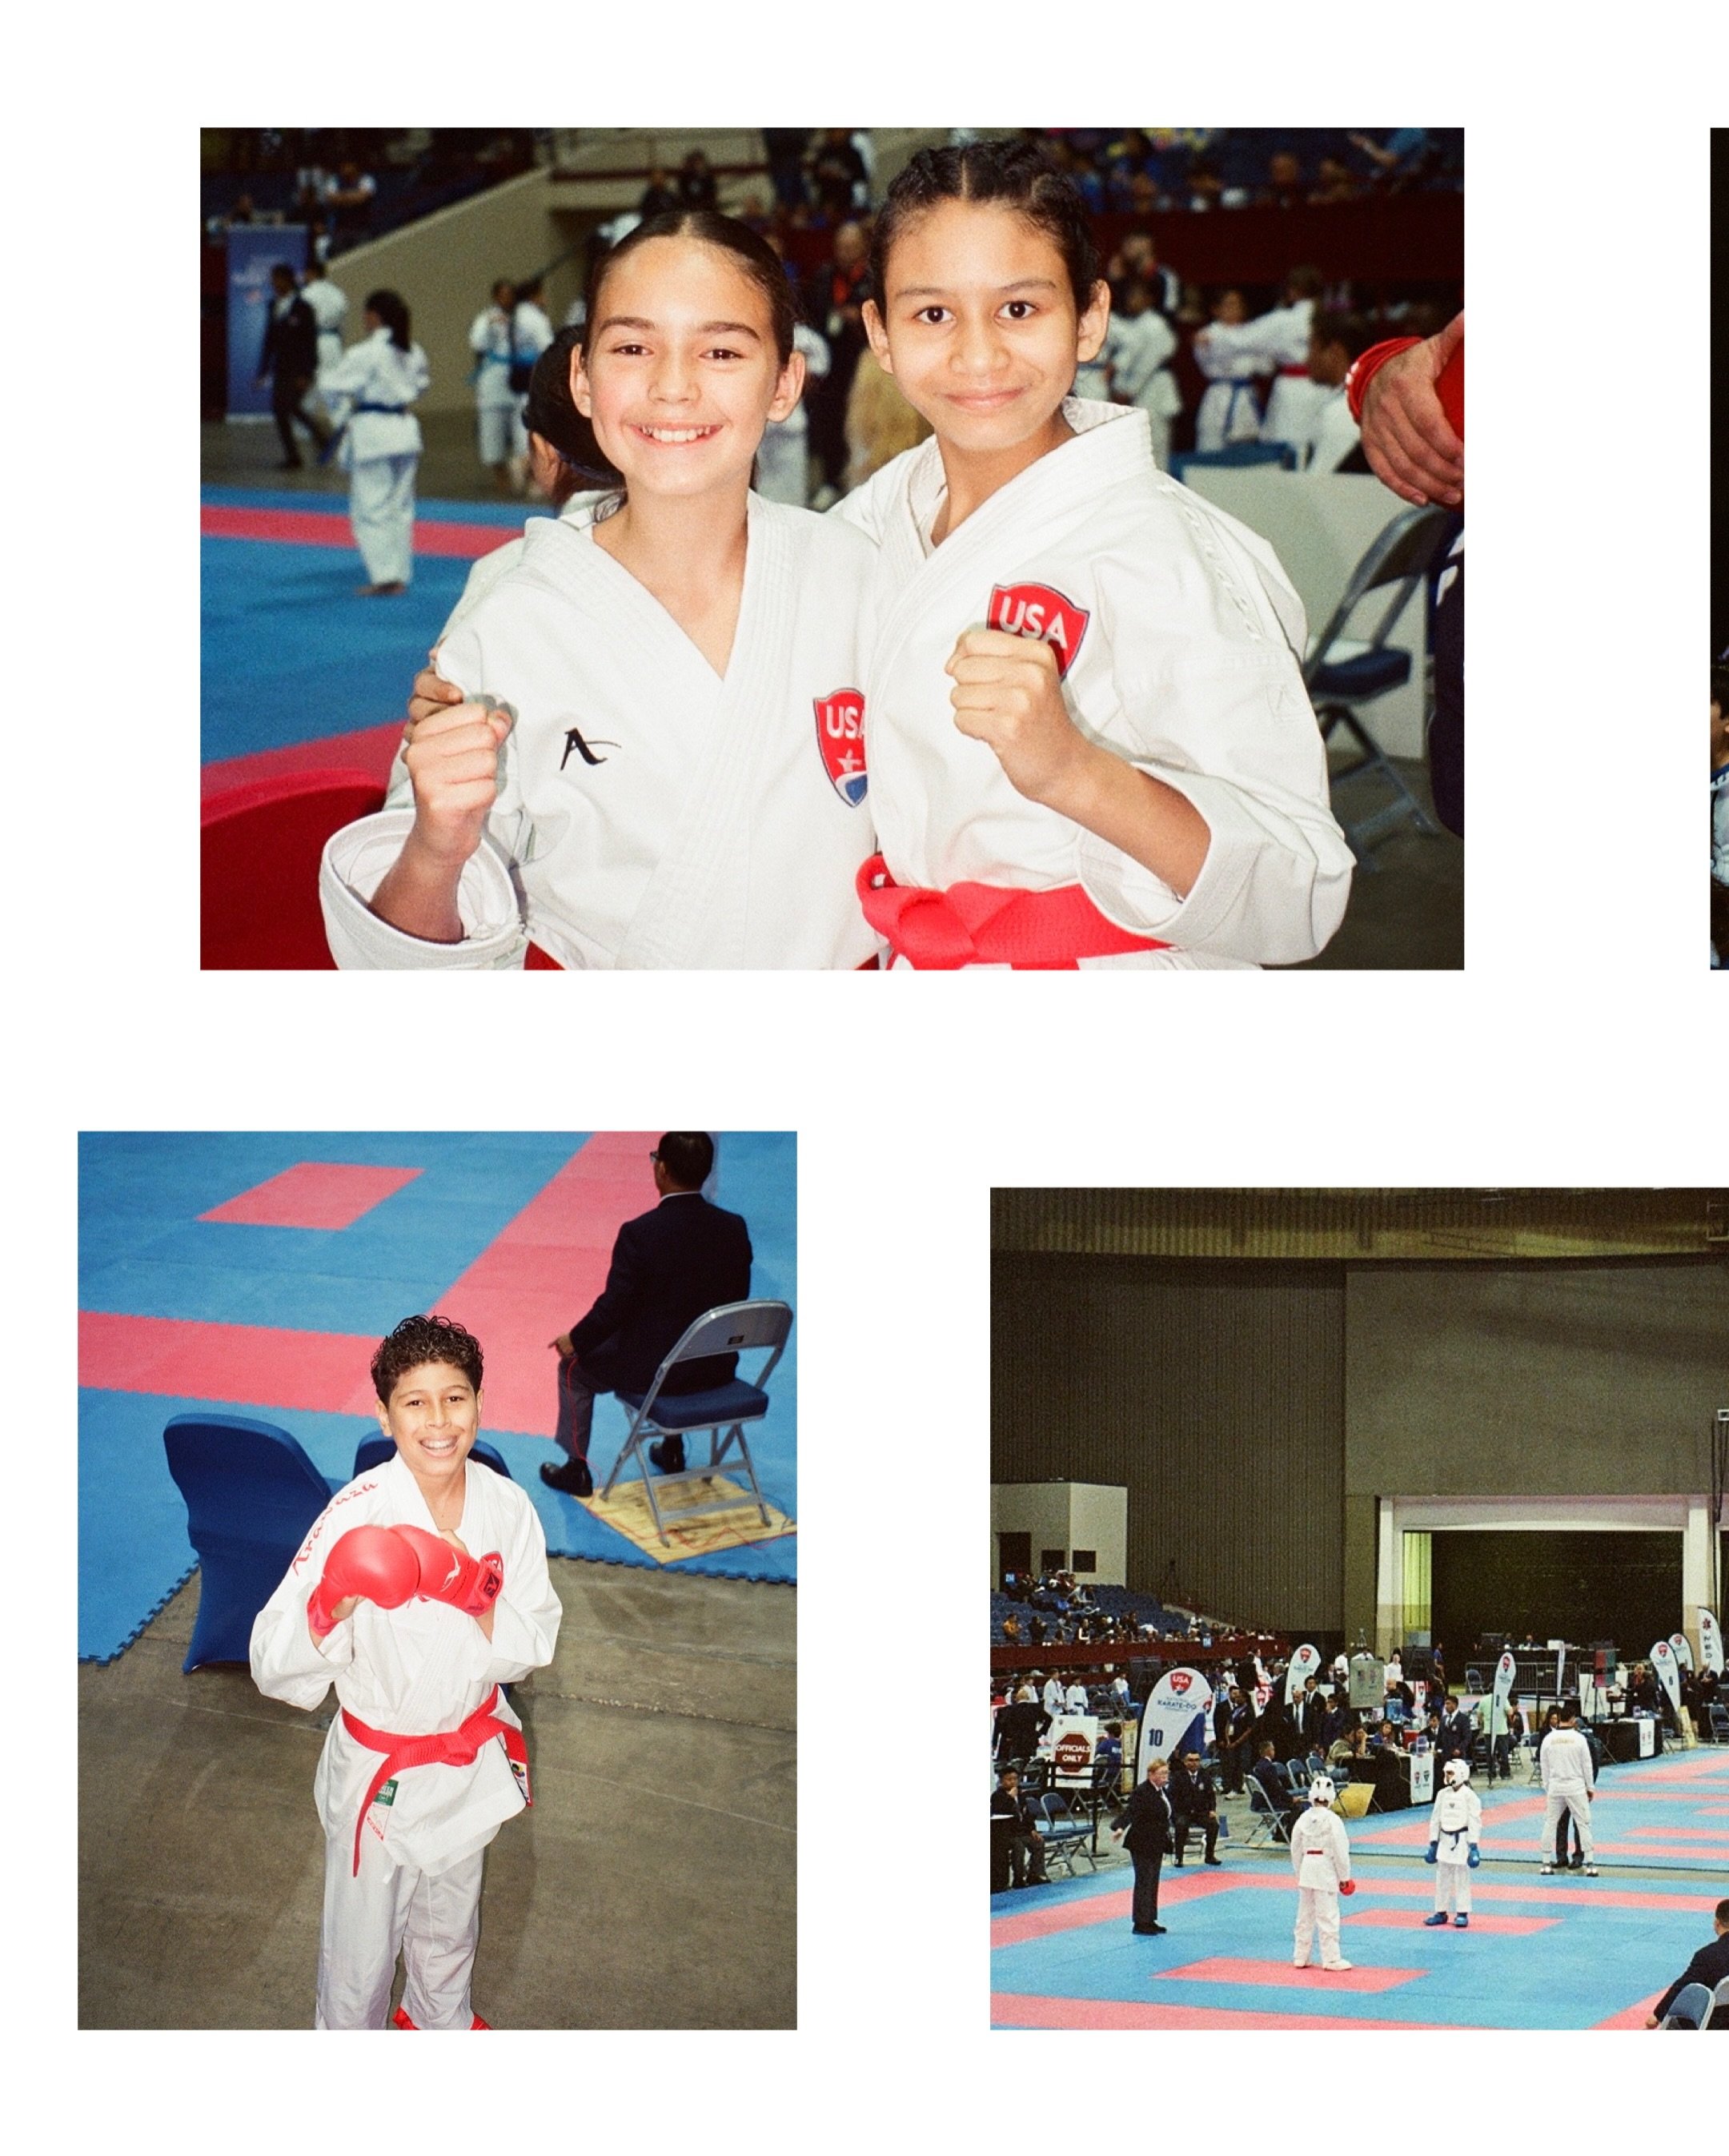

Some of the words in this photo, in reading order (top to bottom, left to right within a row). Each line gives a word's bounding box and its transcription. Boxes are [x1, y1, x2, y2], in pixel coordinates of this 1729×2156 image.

[999, 596, 1068, 649] USA
[1172, 1675, 1189, 1684] USA
[1157, 1699, 1197, 1710] KARATE-DO
[1149, 1728, 1164, 1747] 10
[1057, 1744, 1091, 1753] OFFICIALS
[1061, 1754, 1083, 1762] ONLY
